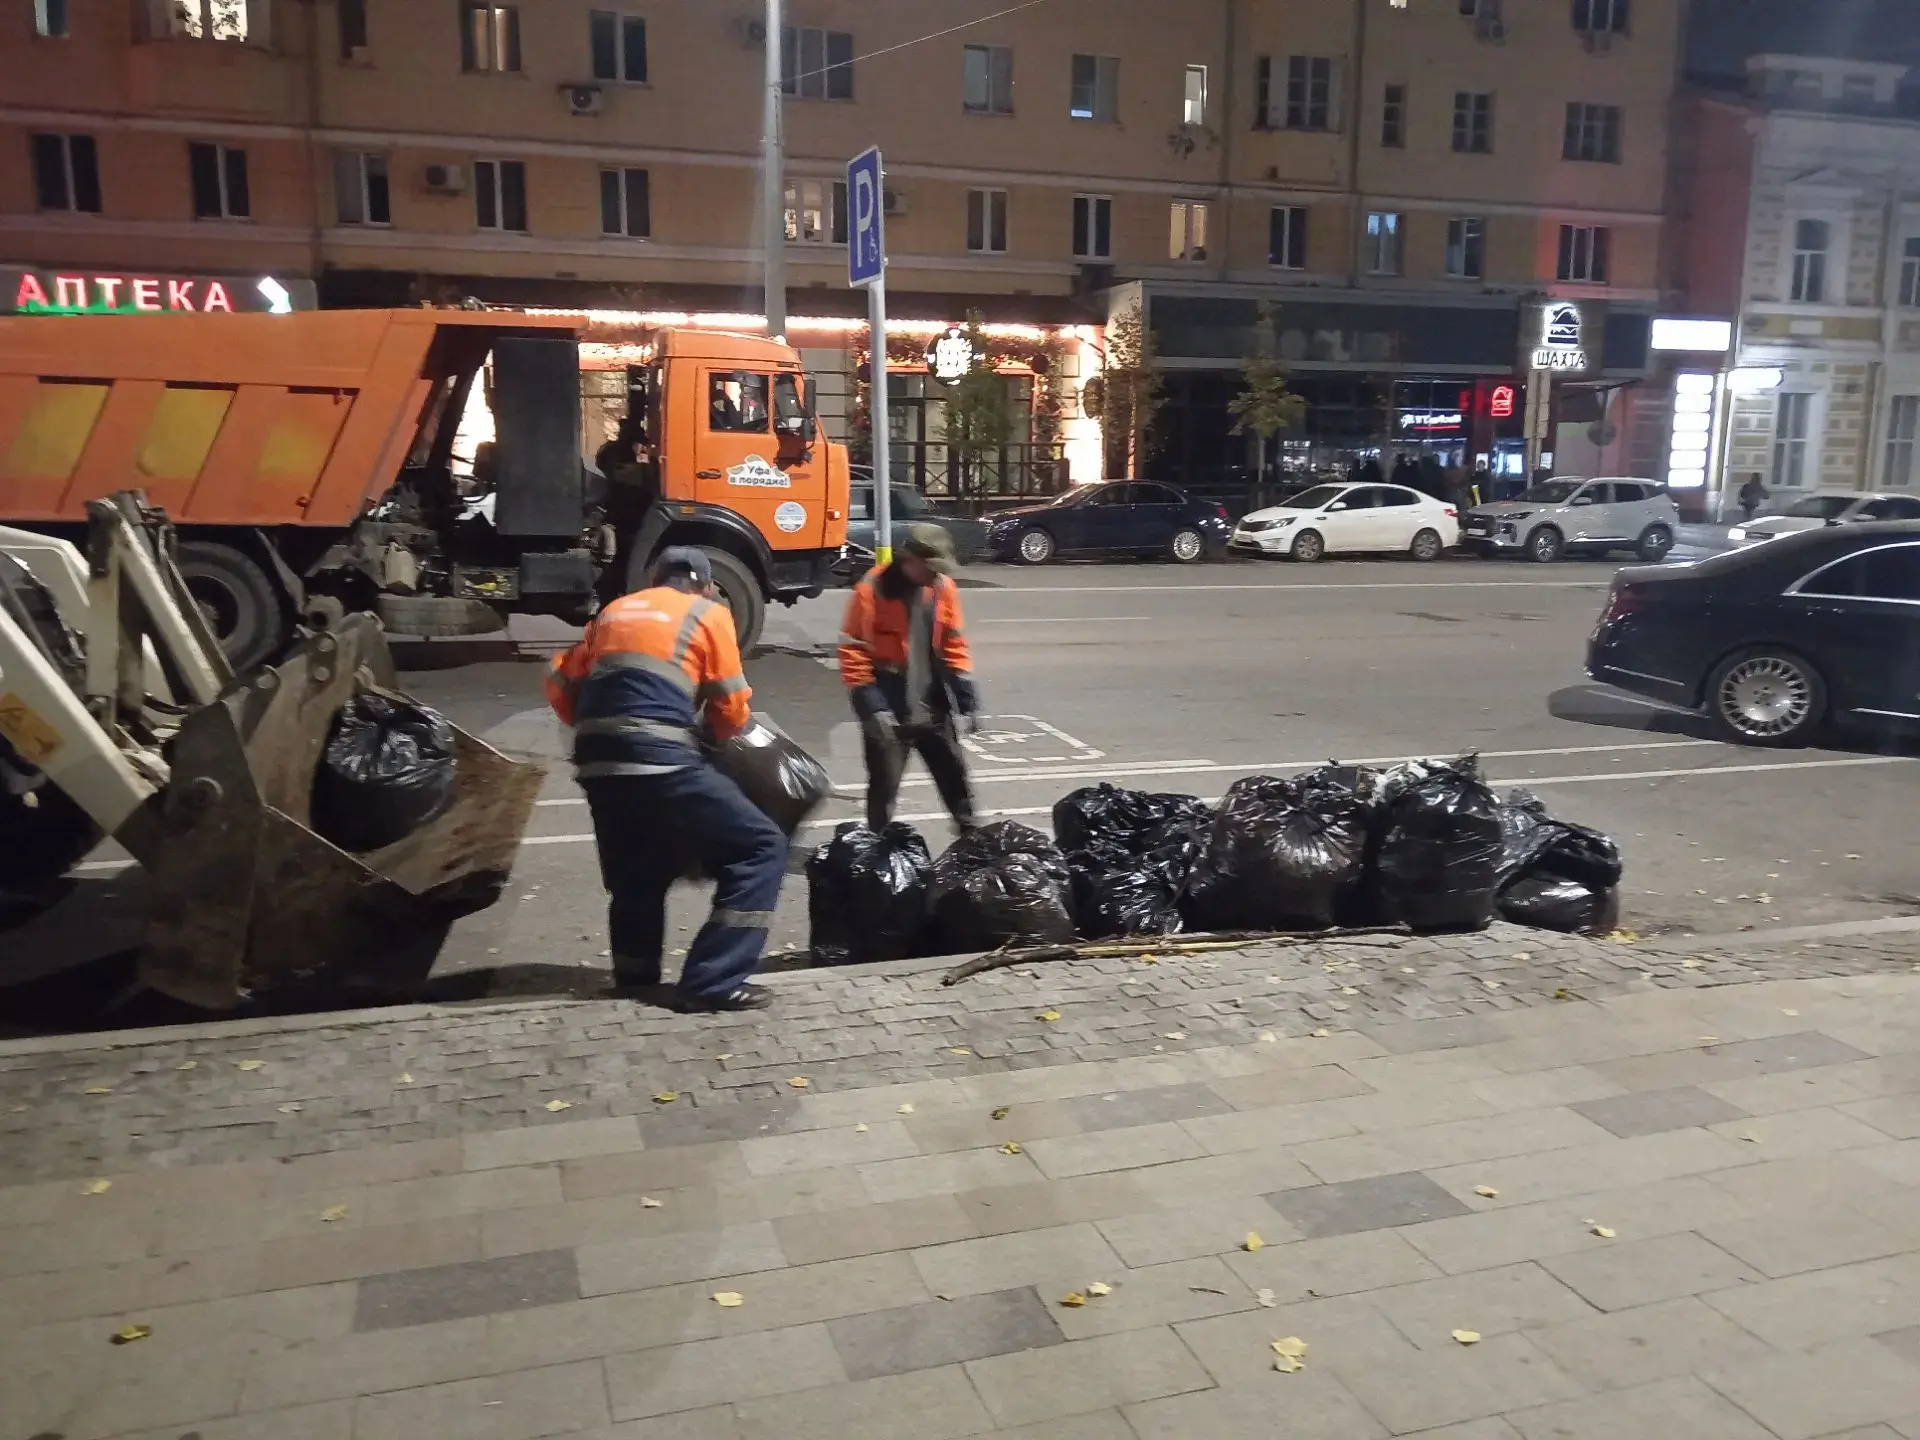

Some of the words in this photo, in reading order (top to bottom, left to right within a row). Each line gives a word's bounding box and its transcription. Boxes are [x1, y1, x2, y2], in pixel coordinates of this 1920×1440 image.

[855, 168, 874, 269] P
[15, 272, 235, 314] АПТЕКА
[1533, 350, 1586, 369] ШАХТА
[747, 465, 771, 476] Уфа
[739, 476, 788, 486] порядке!
